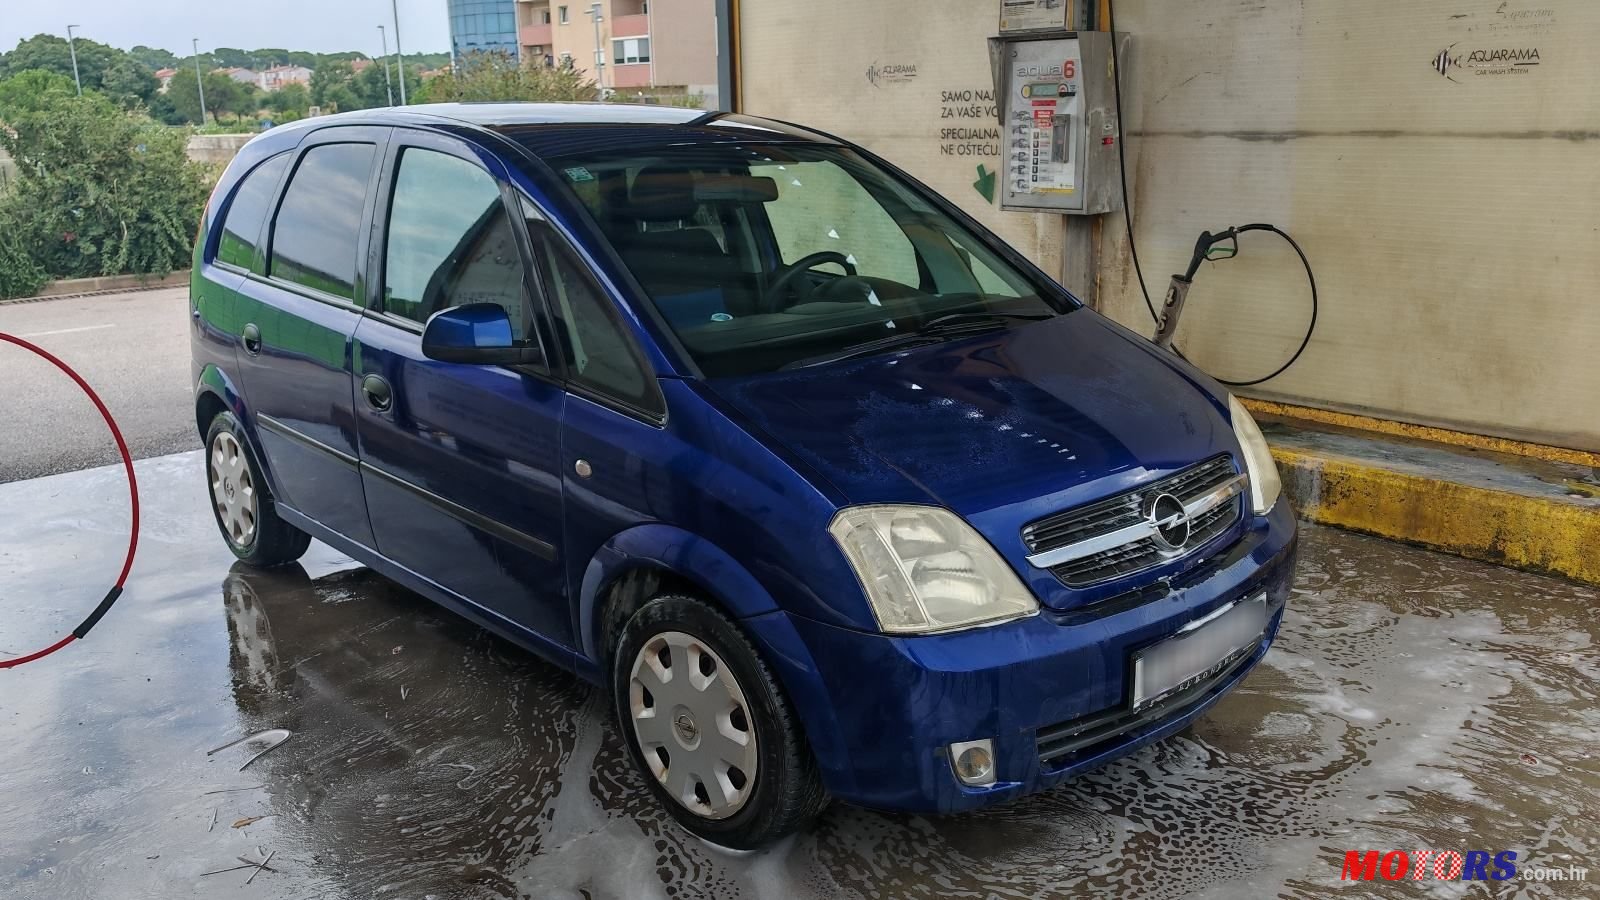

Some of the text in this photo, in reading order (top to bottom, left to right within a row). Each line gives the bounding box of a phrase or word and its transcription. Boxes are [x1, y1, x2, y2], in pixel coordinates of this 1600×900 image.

[1467, 48, 1540, 63] AQUARAMA
[1507, 67, 1529, 75] SYSTEM
[941, 90, 996, 102] SAMO NAJ
[941, 107, 954, 118] ZA
[956, 104, 981, 118] VAŠE
[940, 128, 1000, 140] SPECIJALNA
[940, 144, 954, 155] NE
